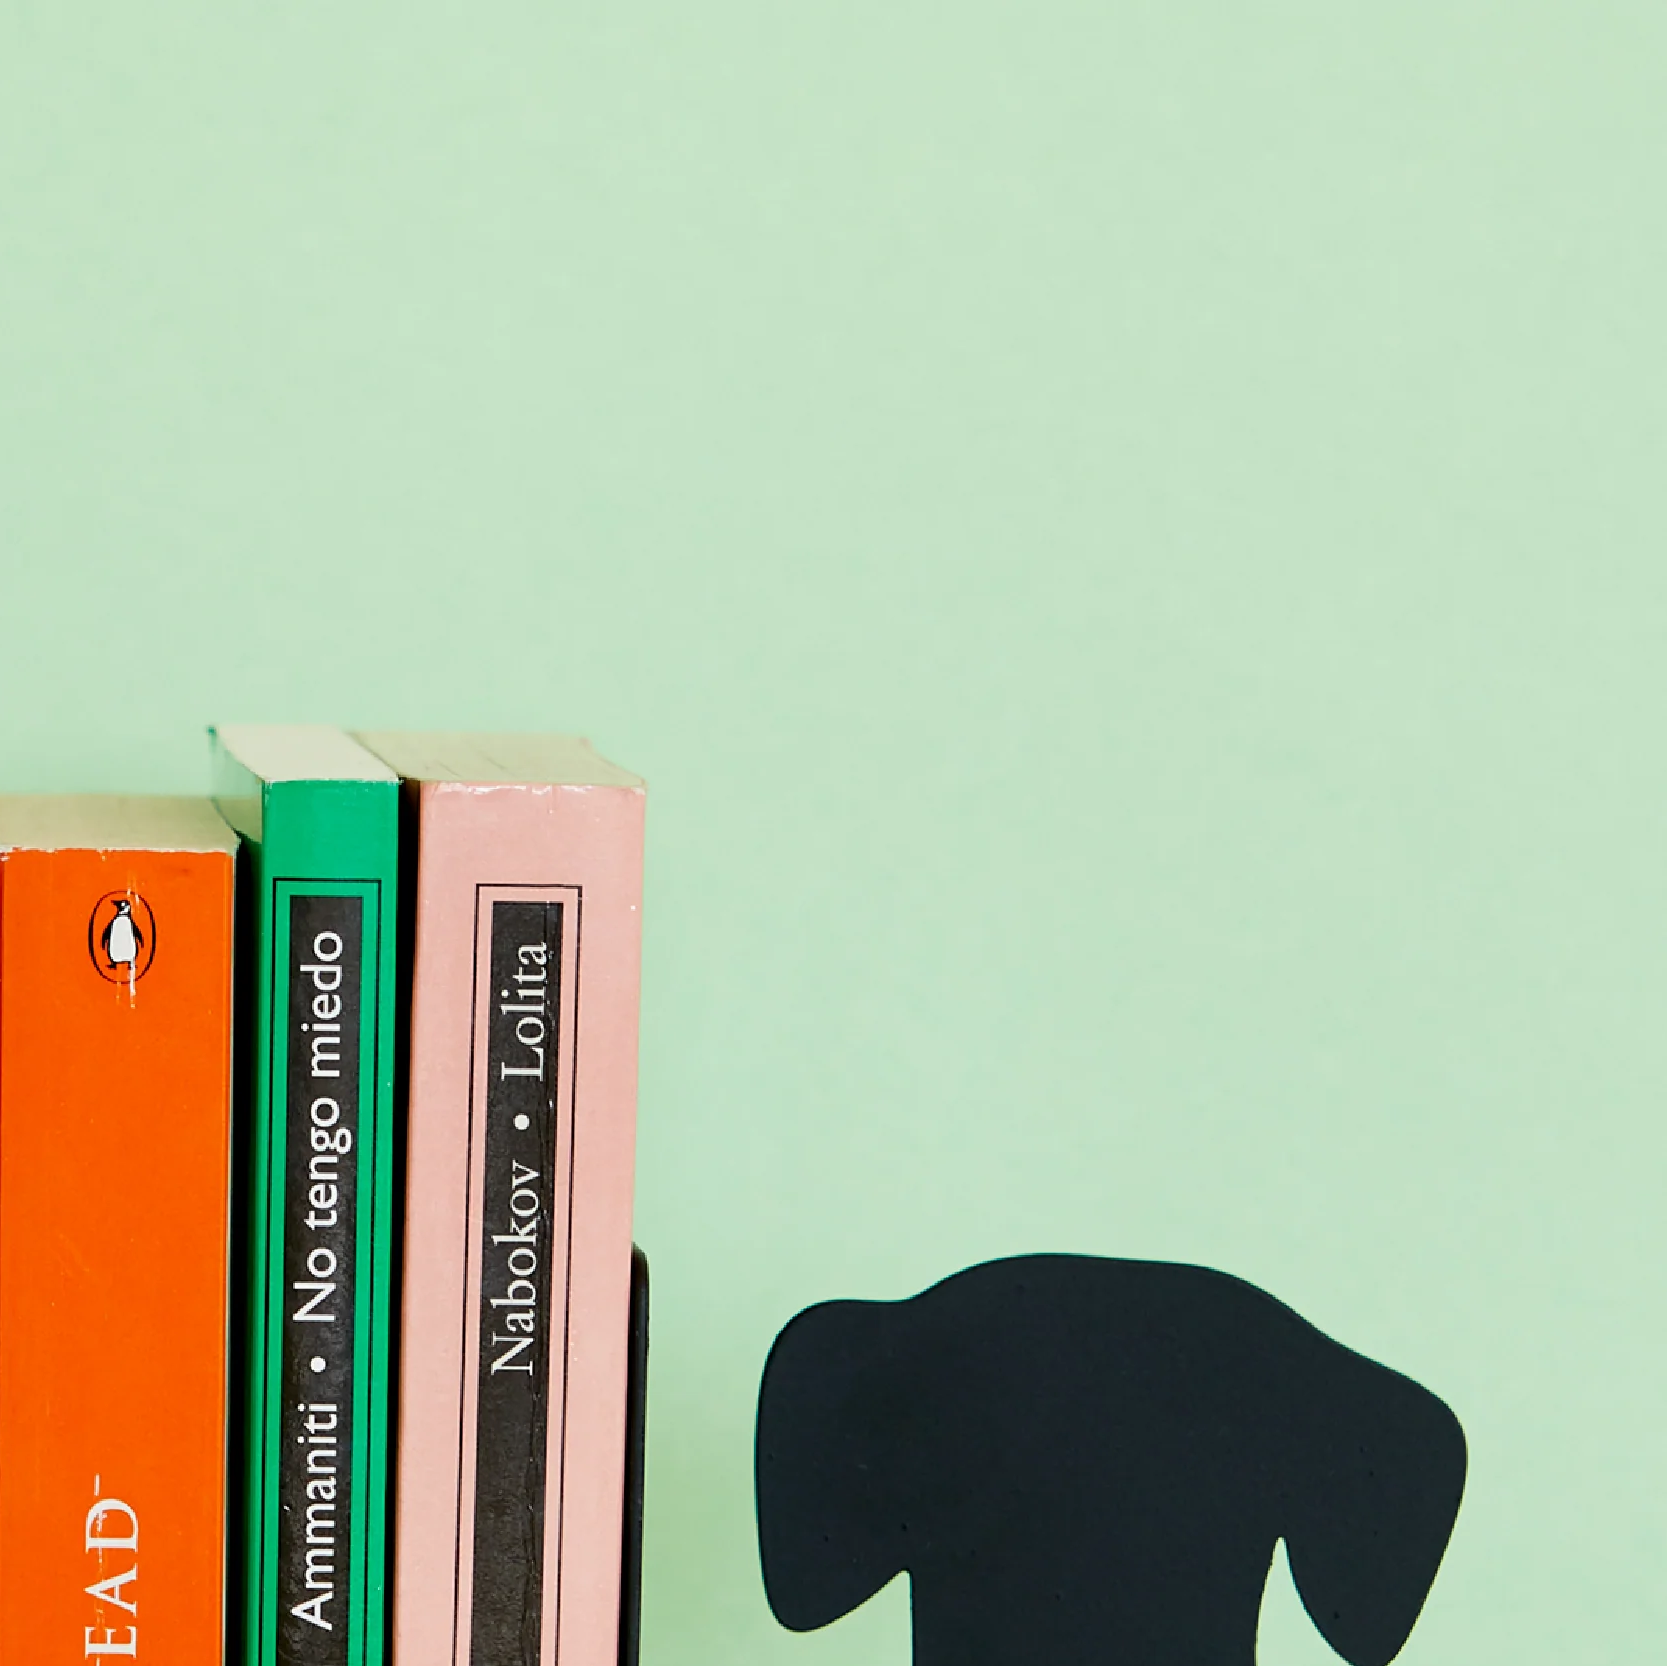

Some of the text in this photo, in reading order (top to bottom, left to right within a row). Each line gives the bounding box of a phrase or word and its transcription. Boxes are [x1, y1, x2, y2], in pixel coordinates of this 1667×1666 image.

[292, 931, 351, 1630] Ammaniti No tengo miedo
[491, 942, 547, 1376] Nabokov Lolita
